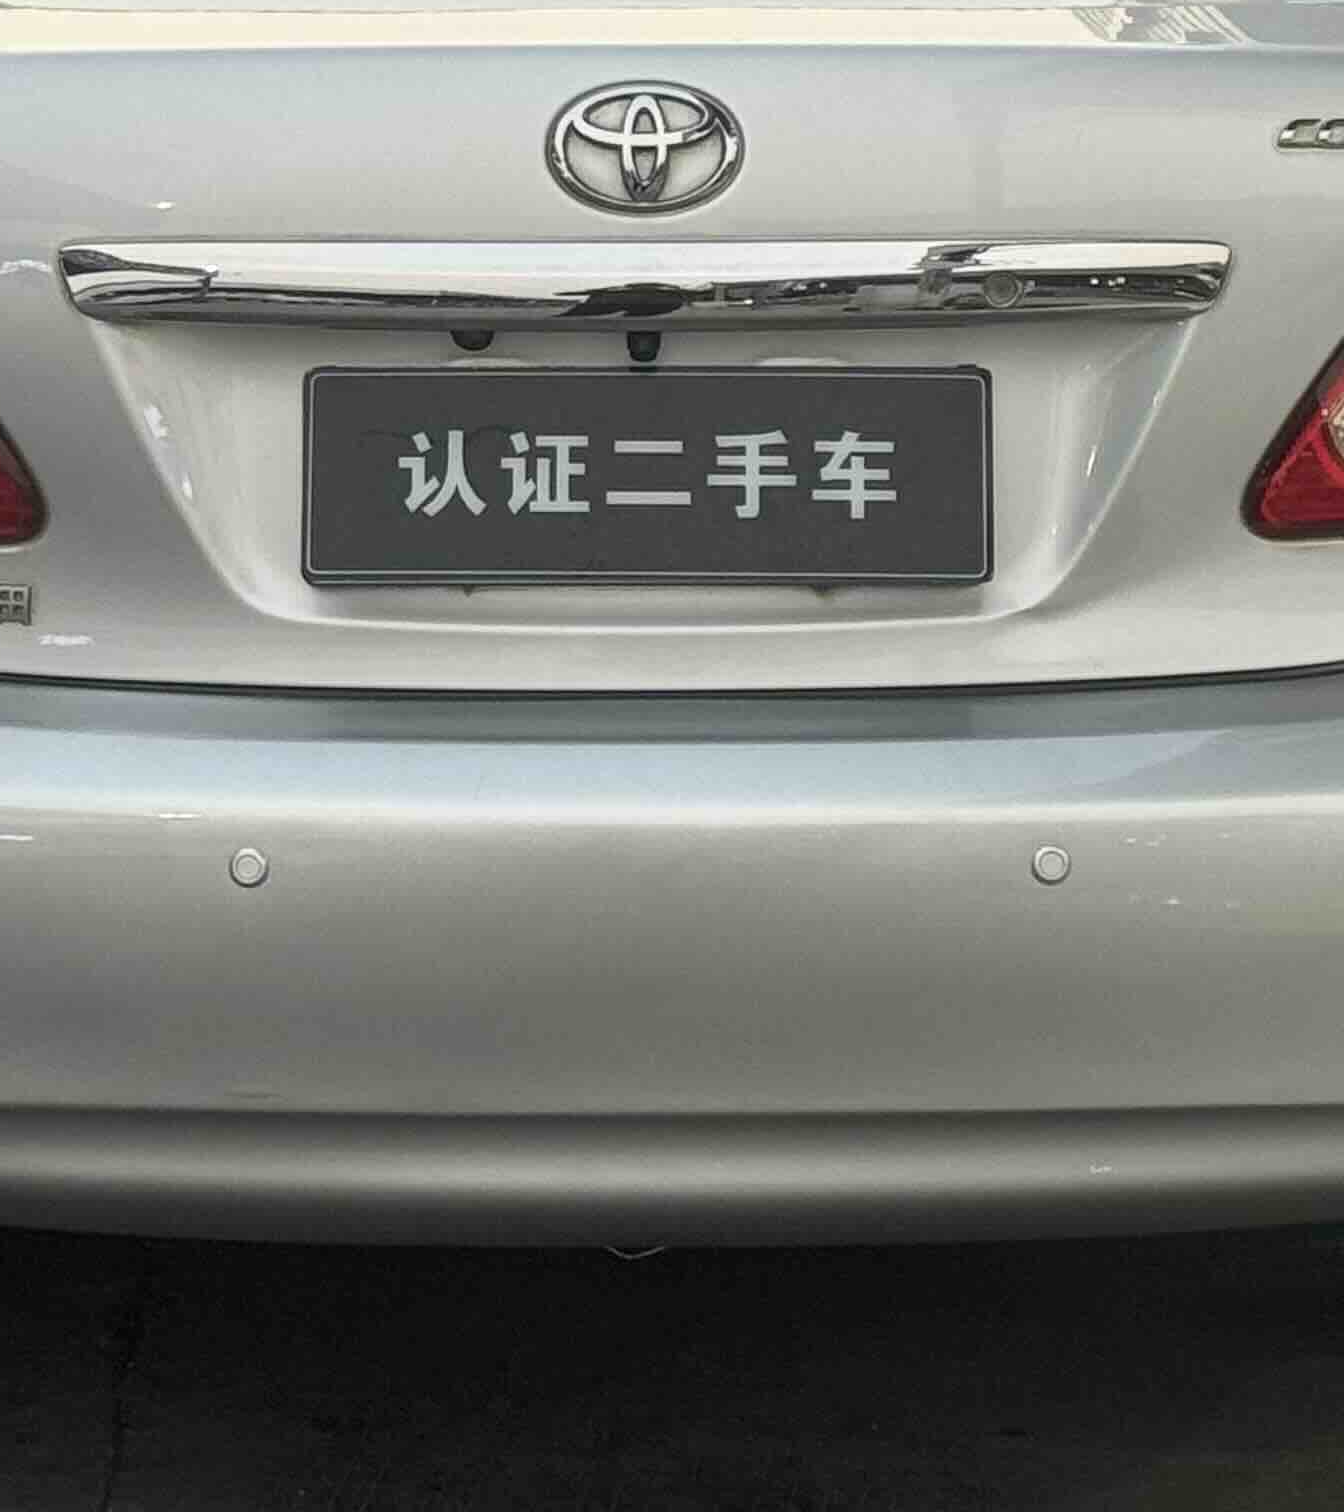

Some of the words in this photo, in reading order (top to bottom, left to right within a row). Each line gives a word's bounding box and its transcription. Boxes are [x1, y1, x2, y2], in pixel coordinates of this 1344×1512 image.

[397, 429, 898, 520] 认证二手车
